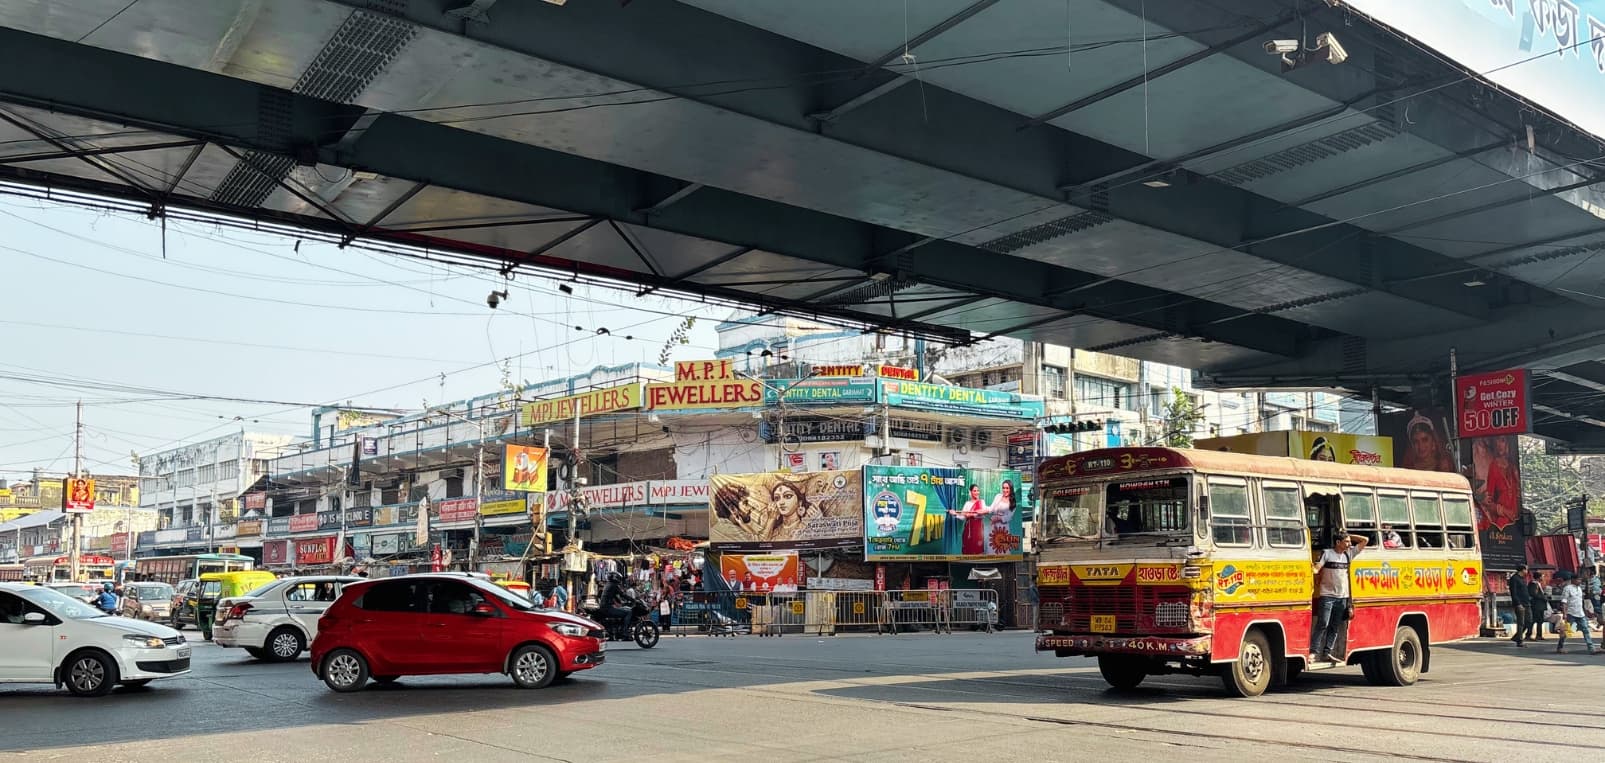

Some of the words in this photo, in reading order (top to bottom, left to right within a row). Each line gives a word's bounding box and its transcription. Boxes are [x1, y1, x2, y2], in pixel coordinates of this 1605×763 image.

[648, 382, 762, 410] JEWELLERS
[811, 388, 841, 398] DENTAL
[902, 383, 945, 399] DENTITY
[949, 388, 987, 404] DENTAL
[1480, 392, 1495, 400] Get
[1496, 390, 1517, 399] Cozy
[530, 401, 552, 424] MPJ
[557, 386, 630, 418] JEWELLERS
[1483, 399, 1514, 408] WINTER
[652, 487, 676, 498] MPJ
[906, 489, 927, 546] 7
[807, 520, 841, 529] Saraswati
[842, 519, 858, 529] Puja
[1085, 566, 1120, 577] TATA
[1045, 639, 1074, 647] SPEED
